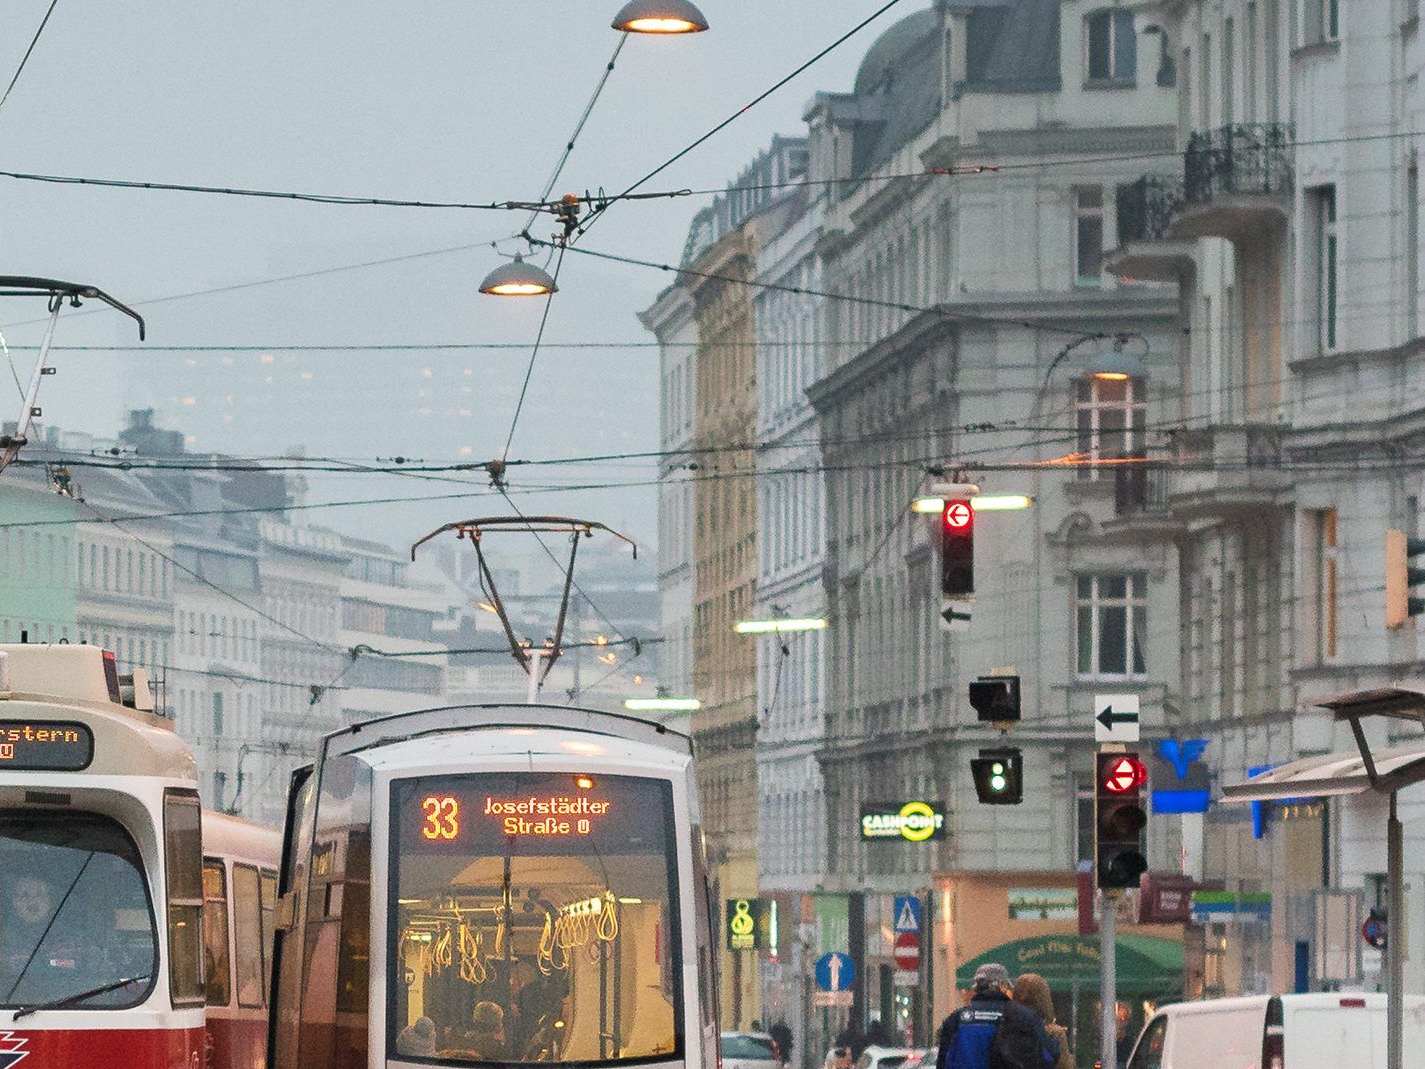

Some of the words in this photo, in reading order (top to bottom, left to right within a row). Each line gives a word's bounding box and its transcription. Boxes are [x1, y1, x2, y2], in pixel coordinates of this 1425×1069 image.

[484, 797, 610, 814] Josefstädter
[422, 797, 459, 839] 33
[503, 817, 570, 834] Straße
